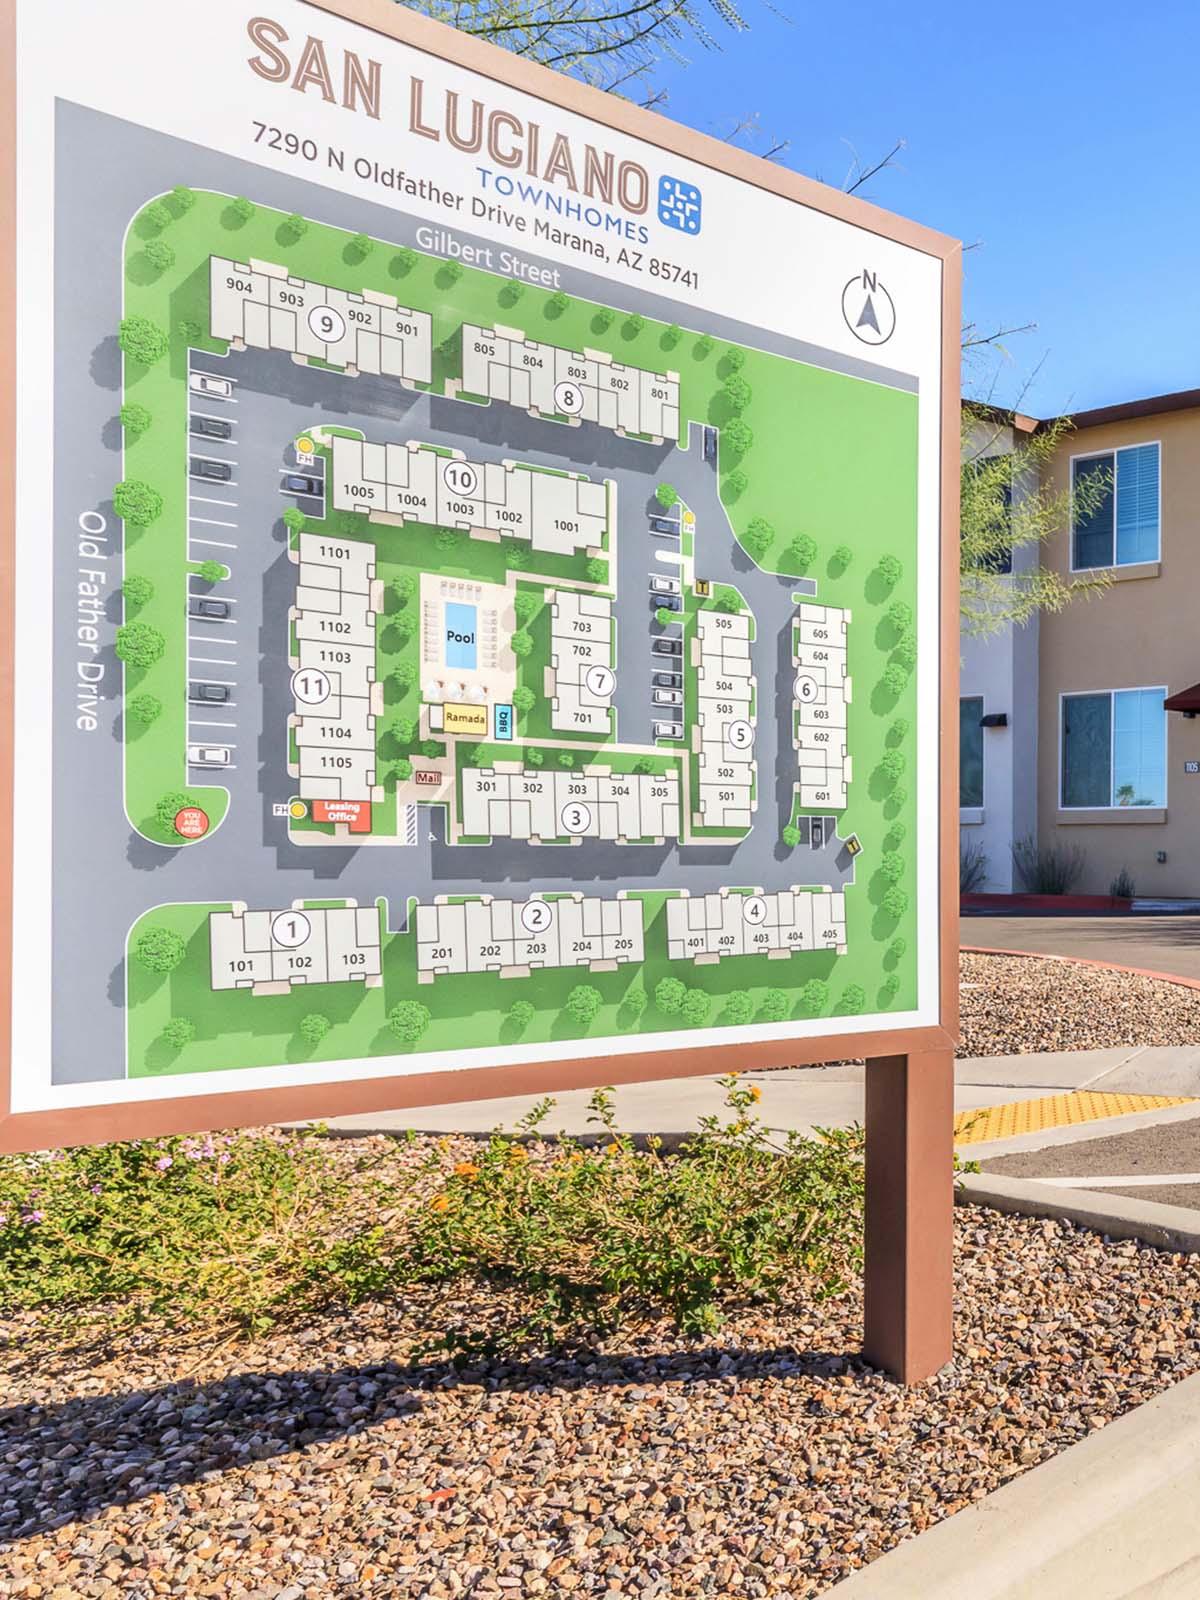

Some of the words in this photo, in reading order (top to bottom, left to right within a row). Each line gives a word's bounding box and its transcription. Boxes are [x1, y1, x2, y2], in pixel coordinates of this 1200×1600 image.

[247, 17, 382, 120] SAN
[409, 76, 649, 216] LUCIANO
[252, 121, 318, 161] 7290
[328, 147, 345, 171] N
[354, 158, 464, 210] Oldfather
[472, 197, 526, 231] Drive
[534, 218, 610, 263] Marana,
[617, 249, 643, 272] AZ
[649, 258, 699, 290] 85741
[476, 167, 649, 244] TOWNHOMES
[415, 227, 493, 268] Gilbert
[500, 251, 561, 288] Street
[226, 277, 253, 294] 904
[863, 268, 876, 293] N
[279, 291, 304, 307] 903
[348, 310, 372, 325] 902
[320, 316, 333, 333] 9
[396, 322, 418, 336] 901
[474, 342, 495, 356] 805
[523, 355, 543, 369] 804
[567, 367, 587, 380] 803
[610, 378, 629, 391] 802
[564, 390, 574, 406] 8
[651, 388, 668, 401] 801
[449, 469, 472, 489] 10
[343, 484, 375, 500] 1005
[397, 493, 427, 508] 1004
[446, 502, 474, 516] 1003
[495, 510, 522, 524] 1002
[554, 519, 579, 533] 1001
[78, 511, 108, 560] Old
[320, 546, 351, 560] 1101
[77, 568, 107, 654] Father
[320, 621, 351, 634] 1102
[572, 621, 592, 633] 703
[715, 618, 732, 629] 505
[446, 630, 475, 644] Pool
[813, 629, 828, 639] 605
[572, 645, 592, 657] 702
[813, 651, 828, 661] 604
[320, 651, 351, 664] 1103
[300, 677, 323, 696] 11
[595, 674, 605, 689] 7
[716, 682, 733, 691] 504
[802, 682, 810, 697] 6
[76, 662, 105, 732] Drive
[716, 705, 733, 714] 503
[813, 710, 829, 719] 603
[446, 712, 485, 724] Ramada
[499, 711, 509, 732] BBQ
[573, 712, 592, 724] 701
[320, 727, 352, 739] 1104
[737, 728, 745, 741] 5
[814, 733, 829, 742] 602
[320, 757, 353, 769] 1105
[1186, 762, 1199, 773] 1105
[418, 773, 441, 783] Mail
[717, 768, 734, 778] 502
[476, 781, 496, 792] 301
[523, 783, 543, 793] 302
[568, 784, 587, 795] 303
[611, 786, 630, 796] 304
[650, 787, 669, 797] 305
[718, 792, 734, 801] 501
[815, 792, 830, 801] 601
[275, 806, 288, 814] FH
[324, 801, 361, 813] Leasing
[328, 811, 357, 822] Office
[572, 810, 581, 826] 3
[532, 909, 542, 924] 2
[750, 904, 760, 917] 4
[287, 920, 296, 938] 1
[822, 929, 838, 939] 405
[718, 936, 735, 946] 402
[753, 933, 770, 943] 403
[787, 931, 803, 941] 404
[572, 942, 592, 952] 204
[614, 939, 633, 949] 205
[687, 938, 704, 947] 401
[432, 948, 452, 959] 201
[480, 945, 501, 956] 202
[526, 944, 547, 954] 203
[288, 957, 312, 968] 102
[342, 953, 366, 965] 103
[229, 960, 254, 972] 101
